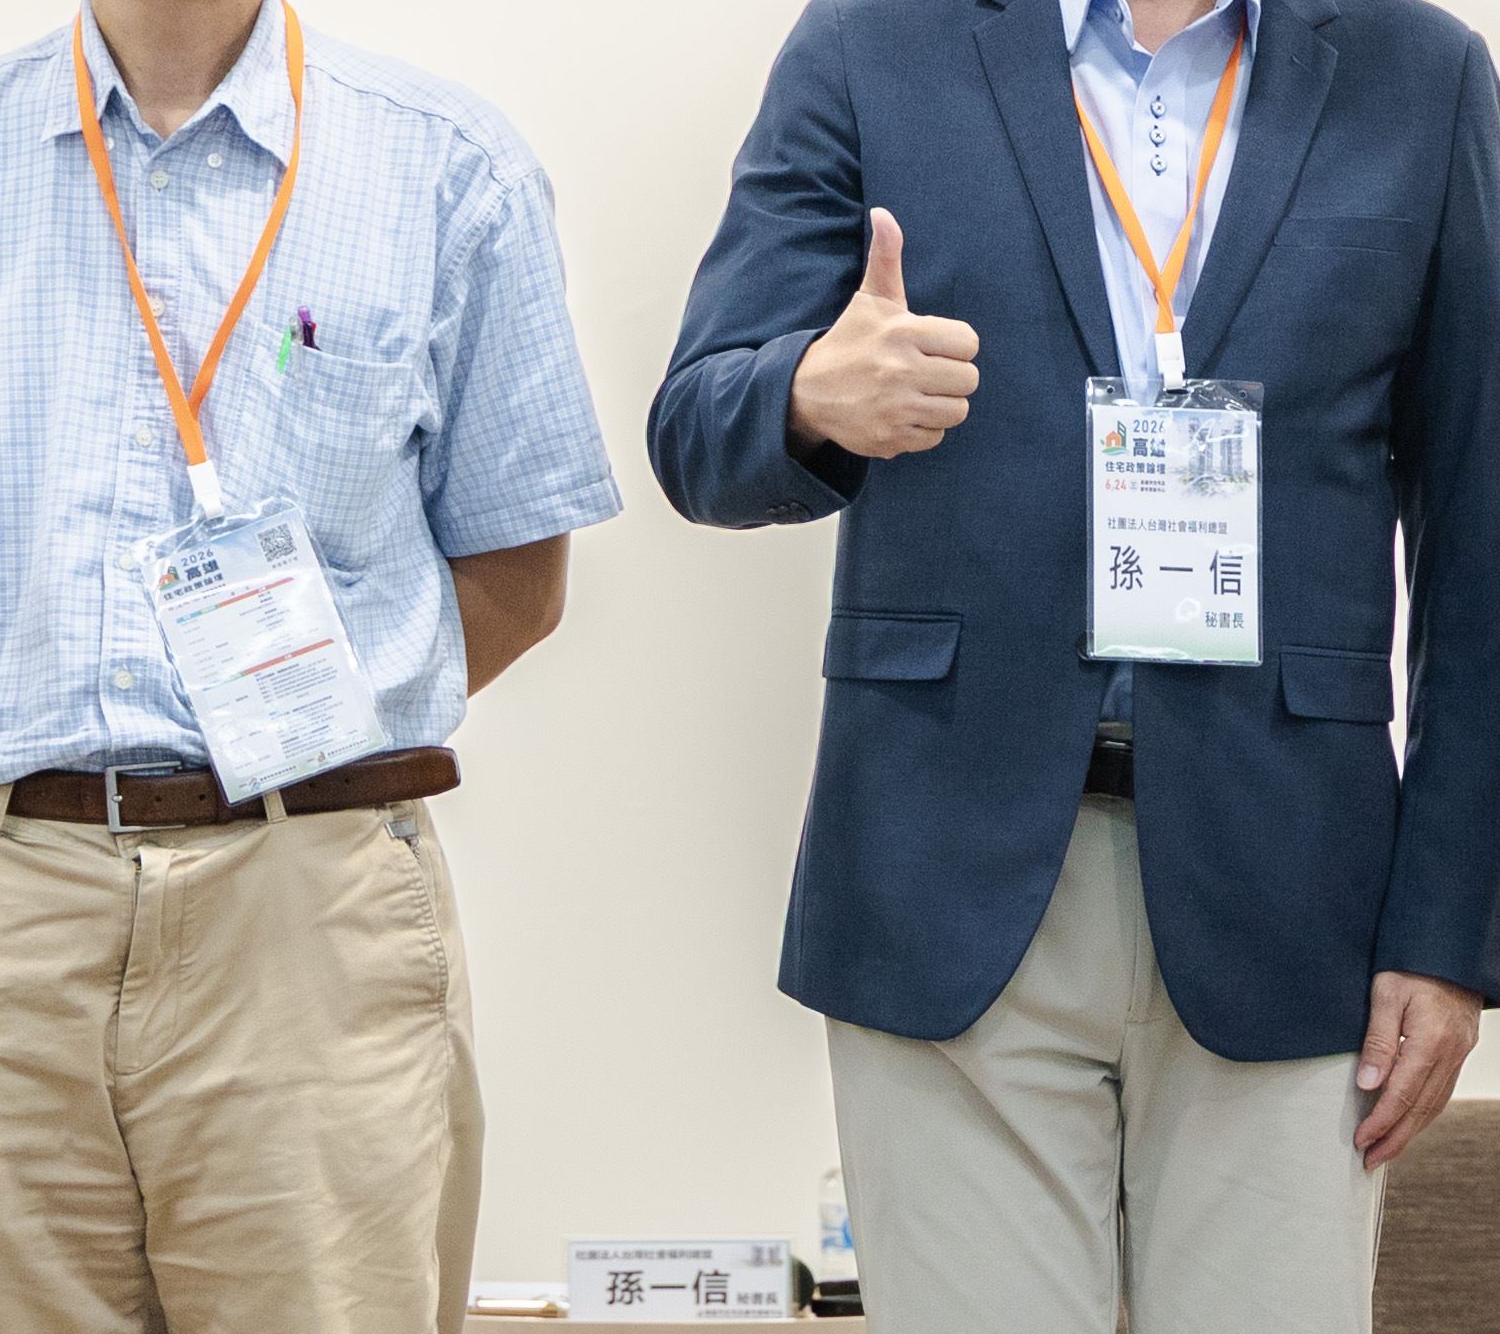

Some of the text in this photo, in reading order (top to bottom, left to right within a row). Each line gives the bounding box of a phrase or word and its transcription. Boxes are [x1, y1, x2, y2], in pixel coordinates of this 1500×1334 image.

[1107, 516, 1228, 535] 社團法人台灣社會福利總盟
[181, 547, 214, 567] 2026
[1109, 545, 1244, 596] 孫一信
[1205, 610, 1245, 629] 秘書長
[606, 1268, 731, 1306] 孫一信
